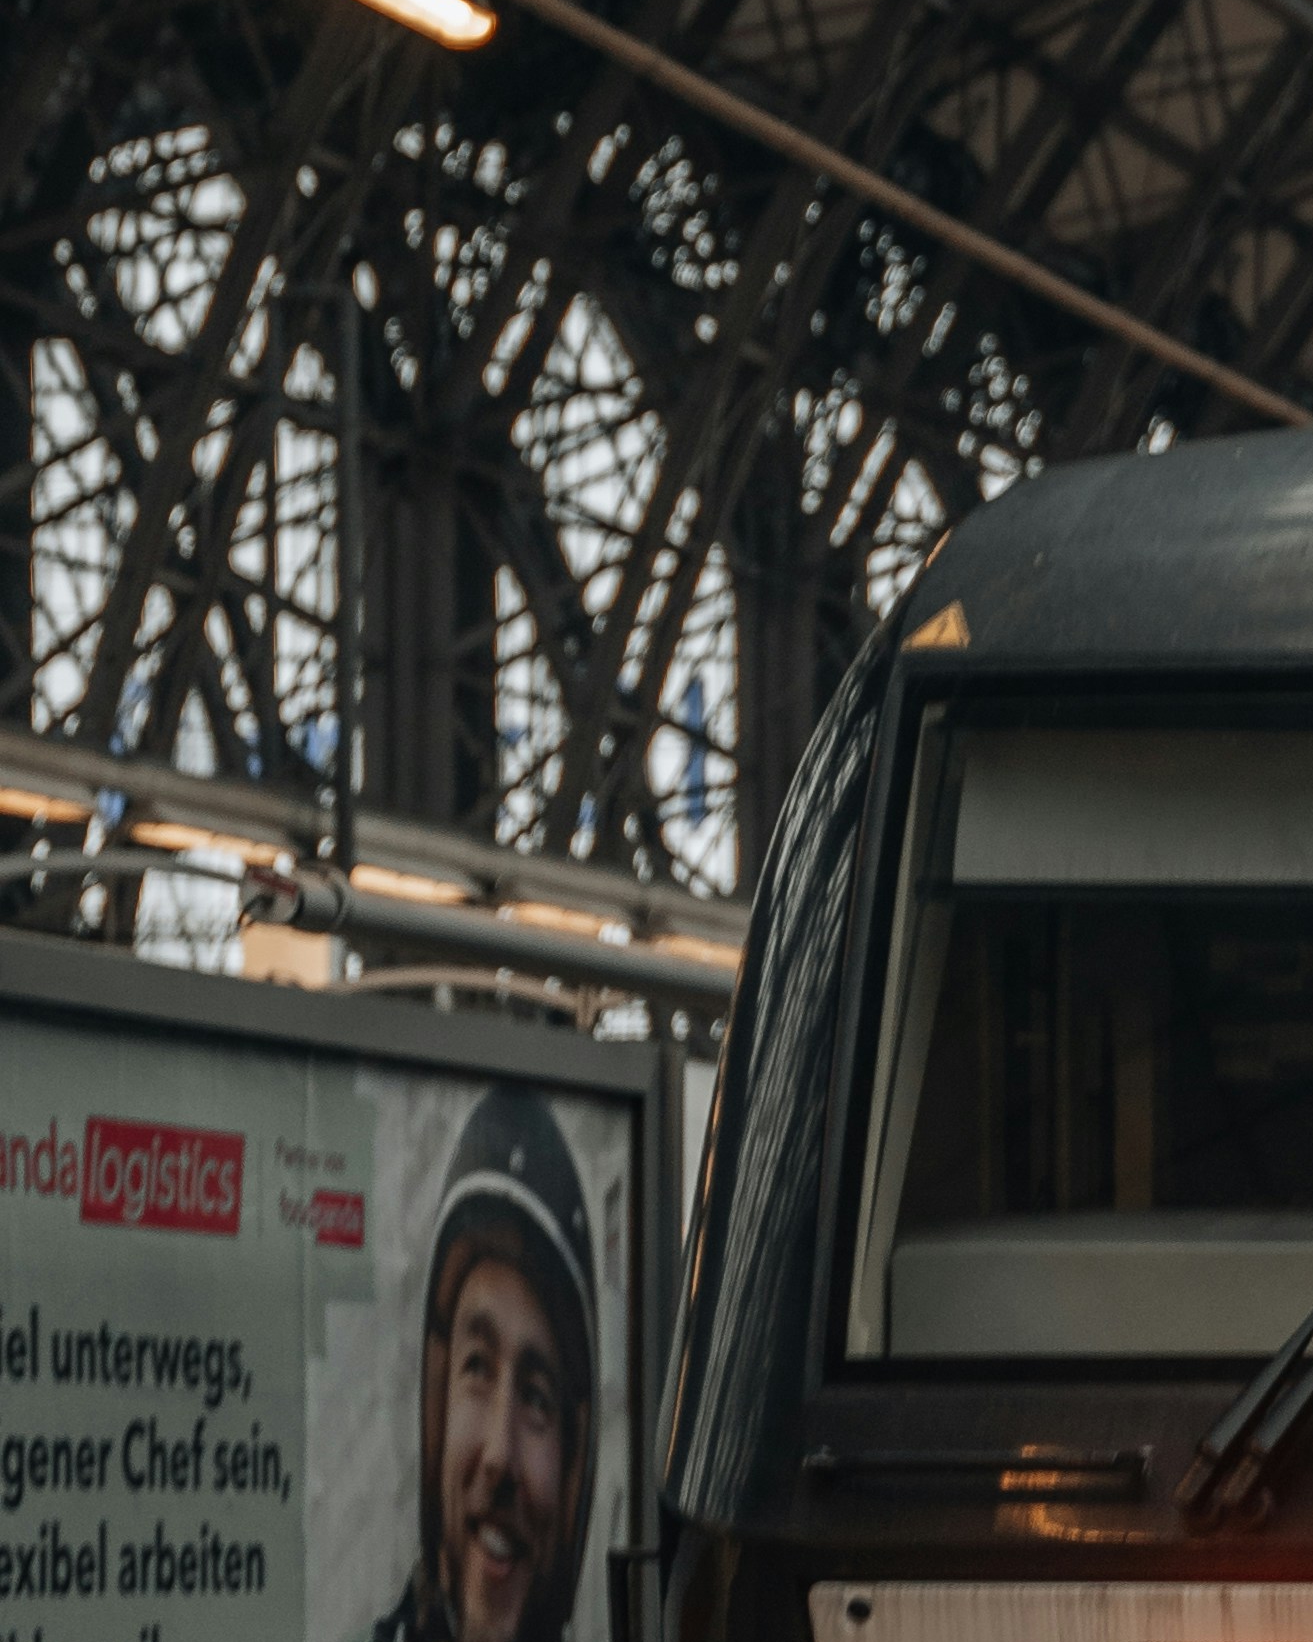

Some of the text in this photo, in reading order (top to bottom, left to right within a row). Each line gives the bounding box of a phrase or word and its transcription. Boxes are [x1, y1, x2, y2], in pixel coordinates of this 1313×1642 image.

[90, 1122, 237, 1225] logistics
[0, 1304, 252, 1410] el unterwegs,
[121, 1415, 207, 1493] Chef
[213, 1419, 292, 1505] sein,
[117, 1519, 266, 1596] arbeiten
